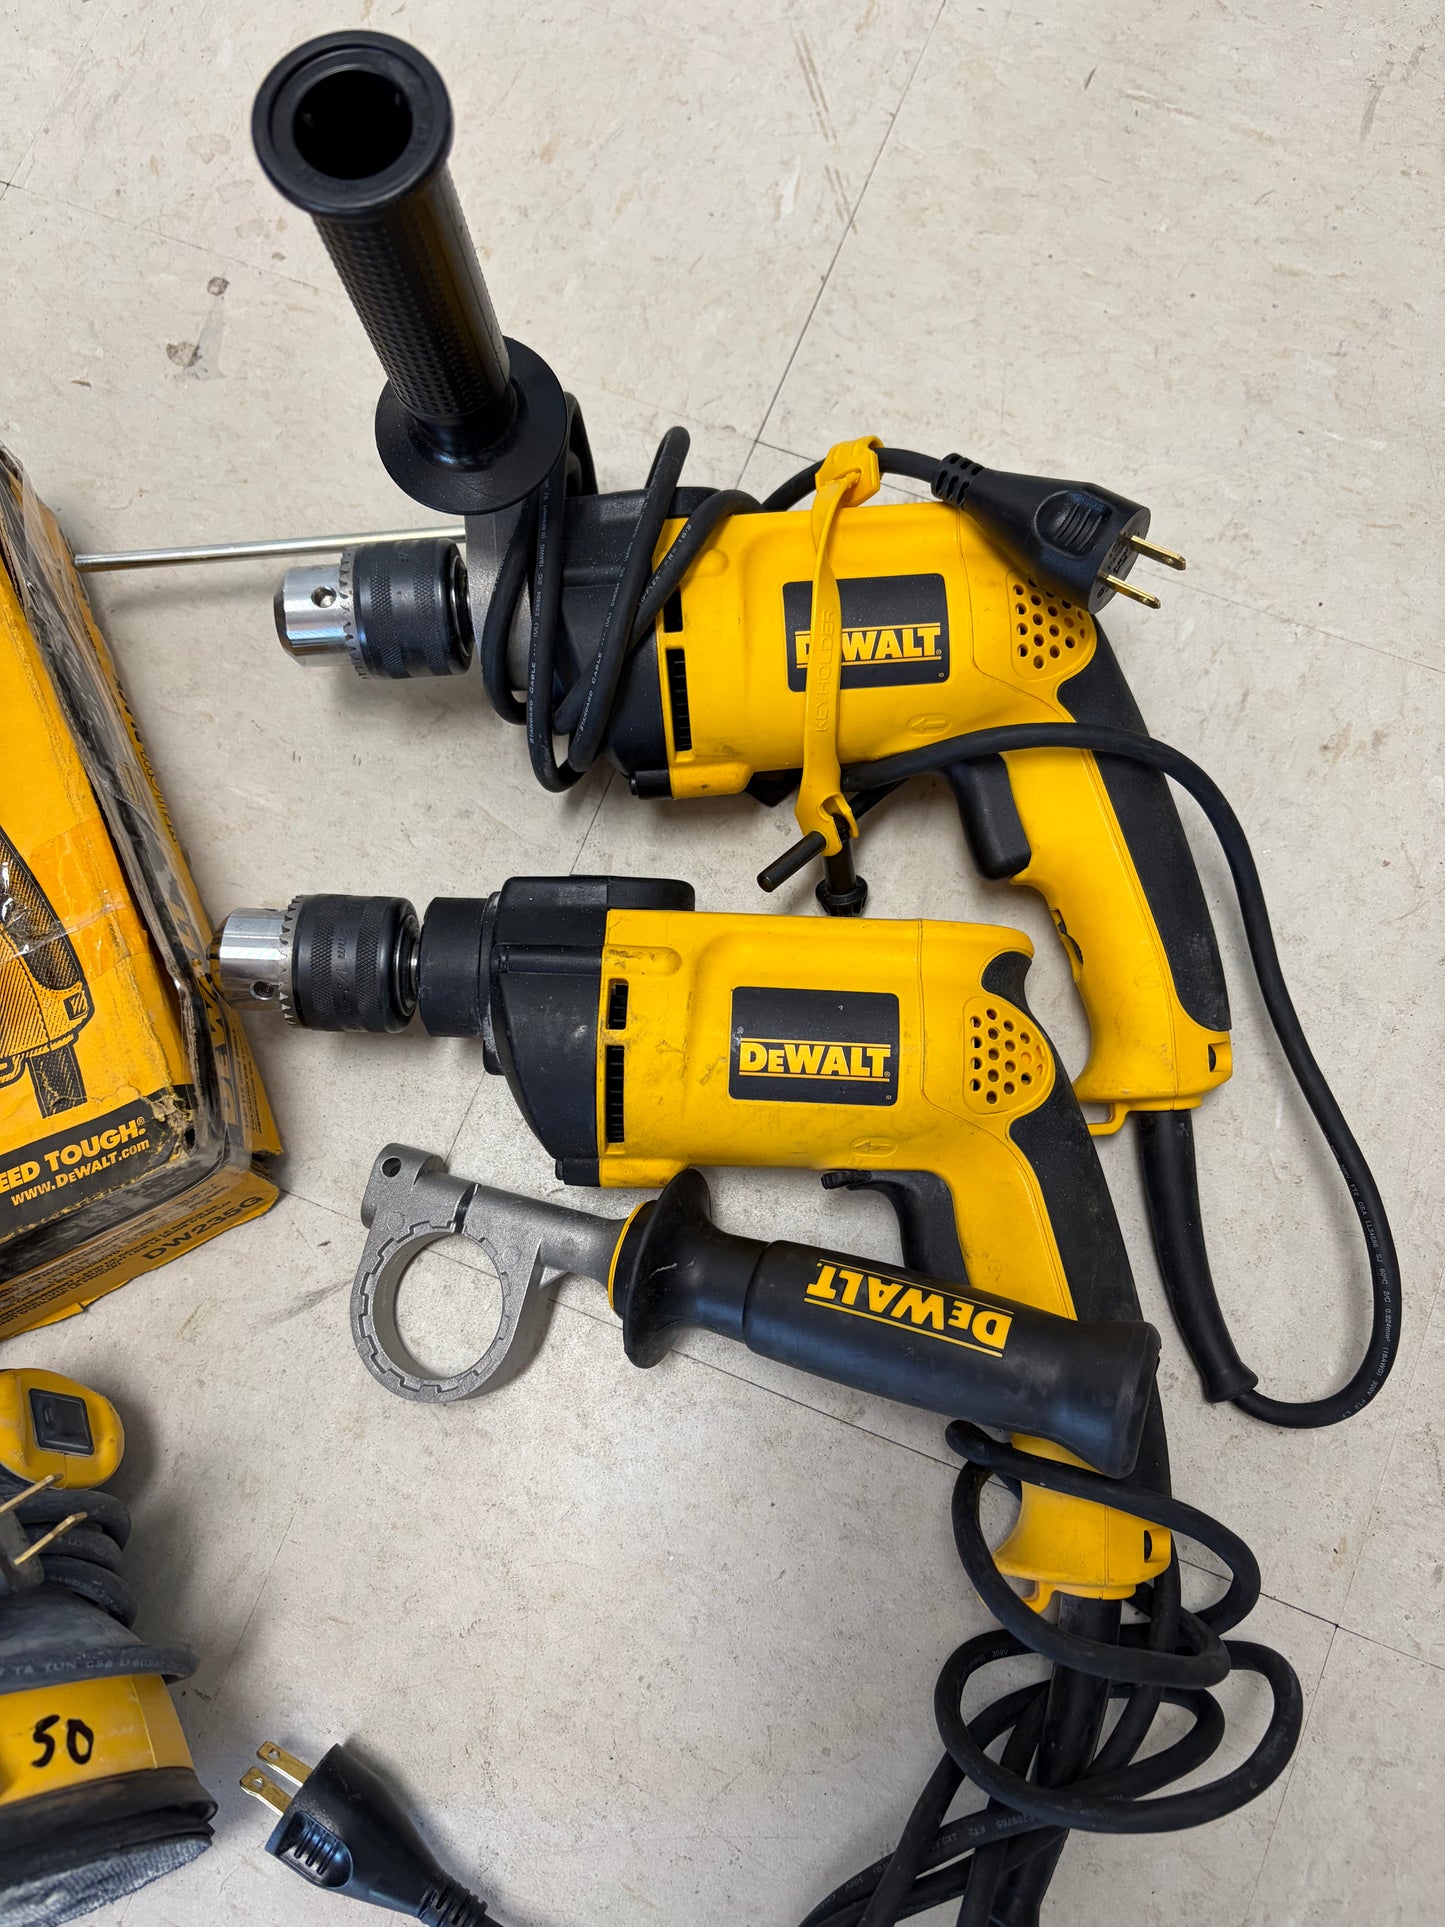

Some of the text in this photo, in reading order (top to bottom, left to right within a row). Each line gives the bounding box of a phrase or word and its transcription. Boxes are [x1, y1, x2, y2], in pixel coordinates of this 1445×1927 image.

[795, 627, 941, 664] DWALT
[142, 1196, 264, 1259] DW235G
[31, 1714, 94, 1768] 50
